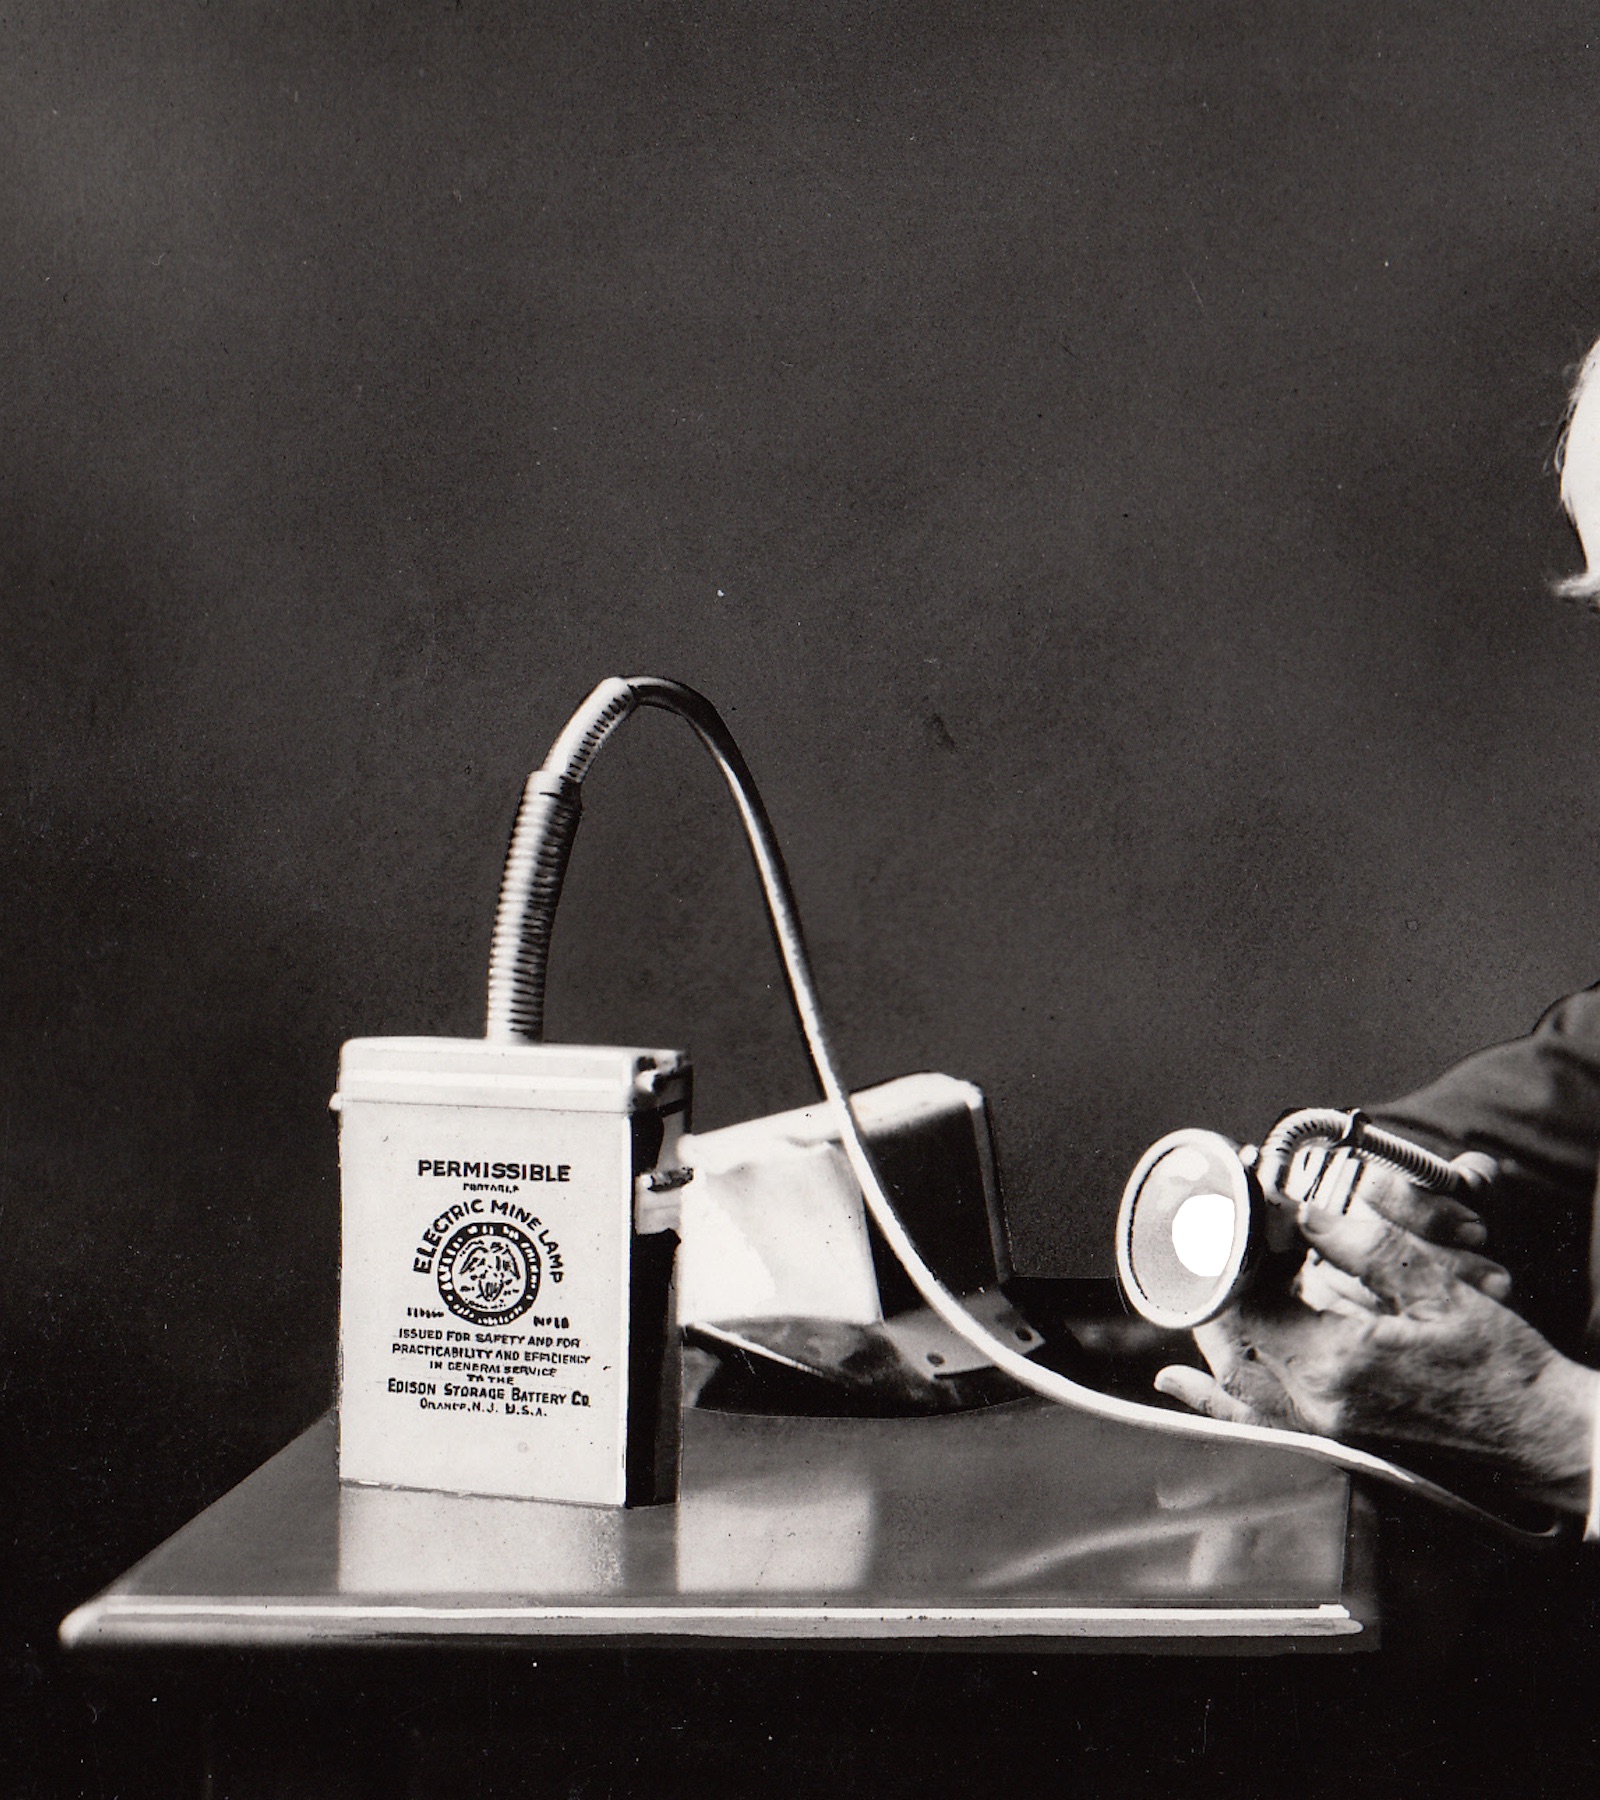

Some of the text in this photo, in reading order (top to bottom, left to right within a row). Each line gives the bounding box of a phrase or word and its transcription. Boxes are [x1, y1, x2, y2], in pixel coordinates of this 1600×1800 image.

[417, 1159, 572, 1183] PERMISSIBLE
[412, 1198, 485, 1275] ELECTRIC
[490, 1199, 542, 1232] MINE
[538, 1229, 564, 1284] LAMP
[398, 1327, 443, 1340] ISSUED
[446, 1330, 471, 1343] FOR
[474, 1332, 526, 1346] SAFETY
[527, 1335, 554, 1348] AND
[392, 1342, 494, 1360] PRACTICABILITY
[495, 1350, 520, 1361] AND
[429, 1360, 443, 1370] IN
[503, 1365, 557, 1378] SERVICE
[487, 1374, 514, 1386] THE
[387, 1377, 437, 1396] EDISON
[443, 1382, 505, 1400] STORAGE
[511, 1386, 567, 1406] BATTERY
